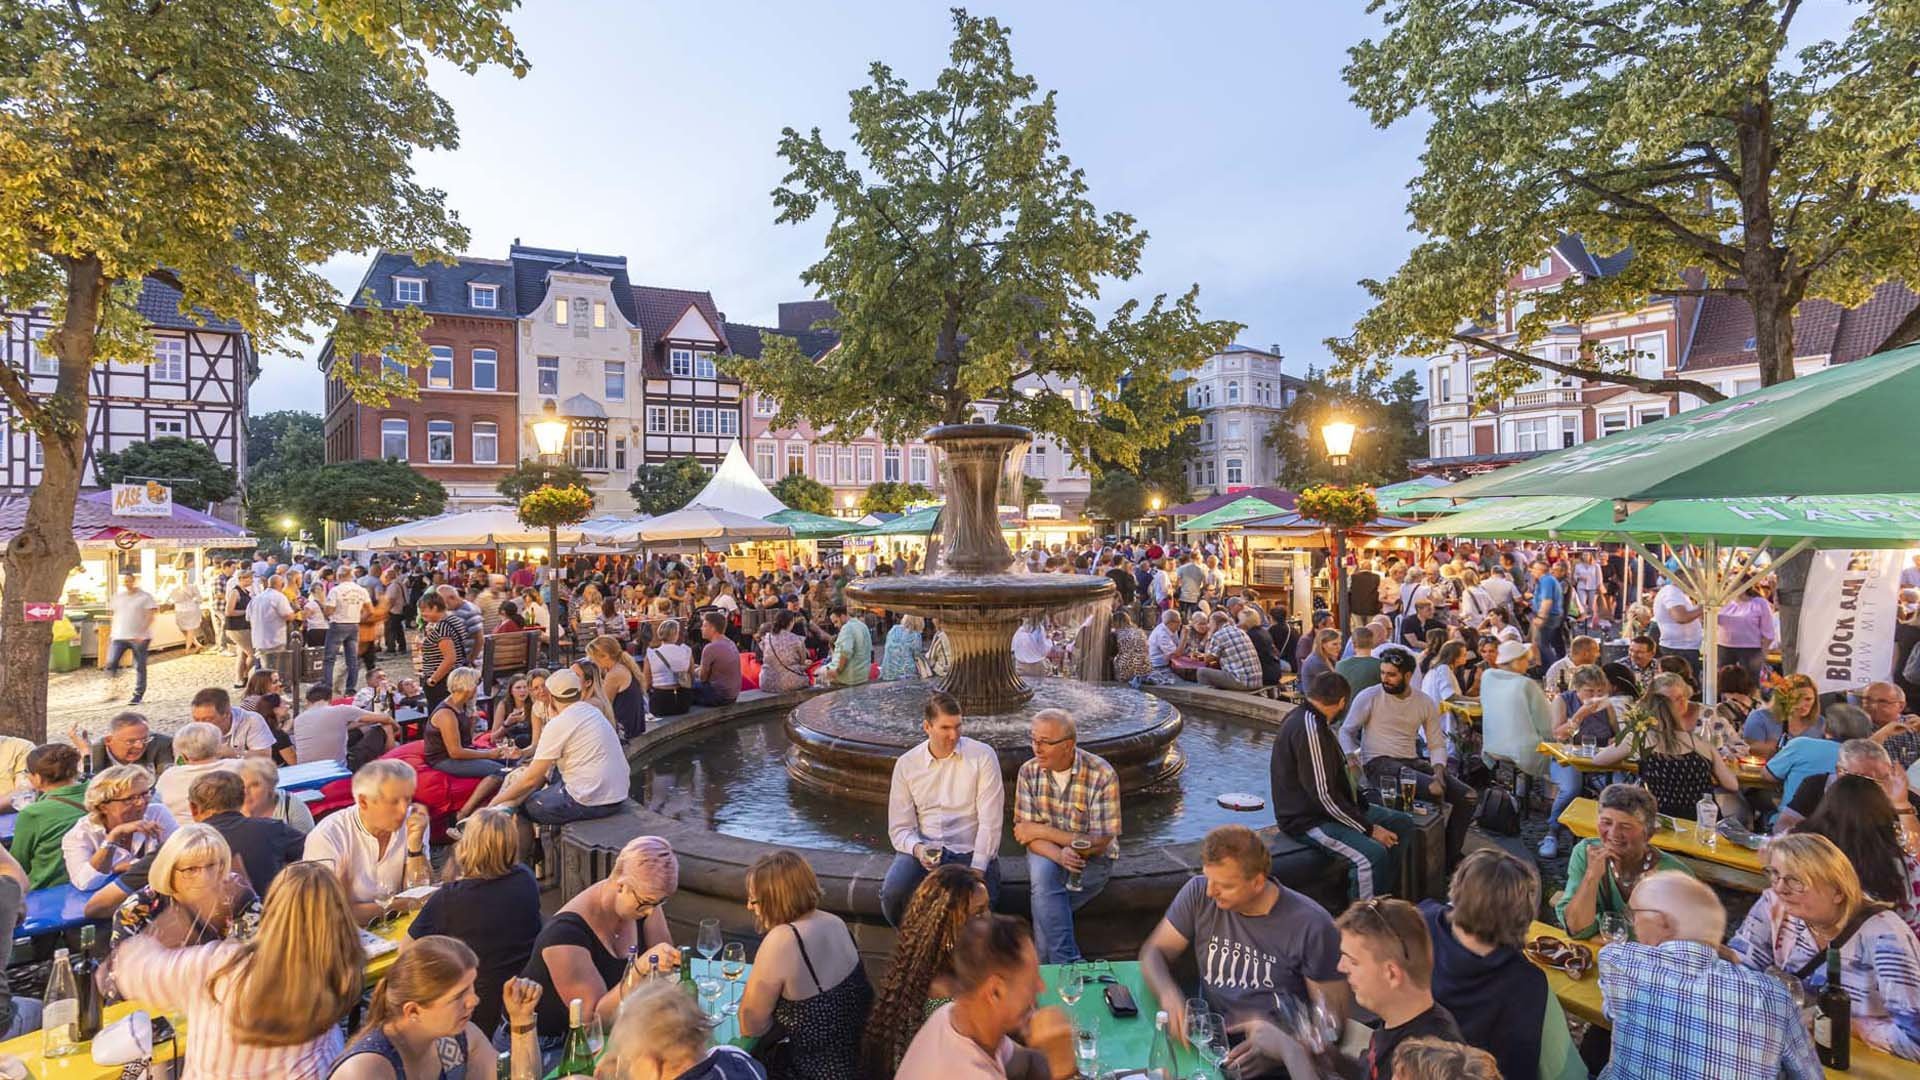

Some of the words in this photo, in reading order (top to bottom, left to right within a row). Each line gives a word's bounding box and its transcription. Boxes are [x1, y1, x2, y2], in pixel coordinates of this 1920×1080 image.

[115, 486, 142, 509] KÄSE
[1840, 578, 1866, 611] AM
[1861, 600, 1877, 632] MIT
[1826, 617, 1855, 682] BLOCK
[1857, 641, 1872, 684] BMW
